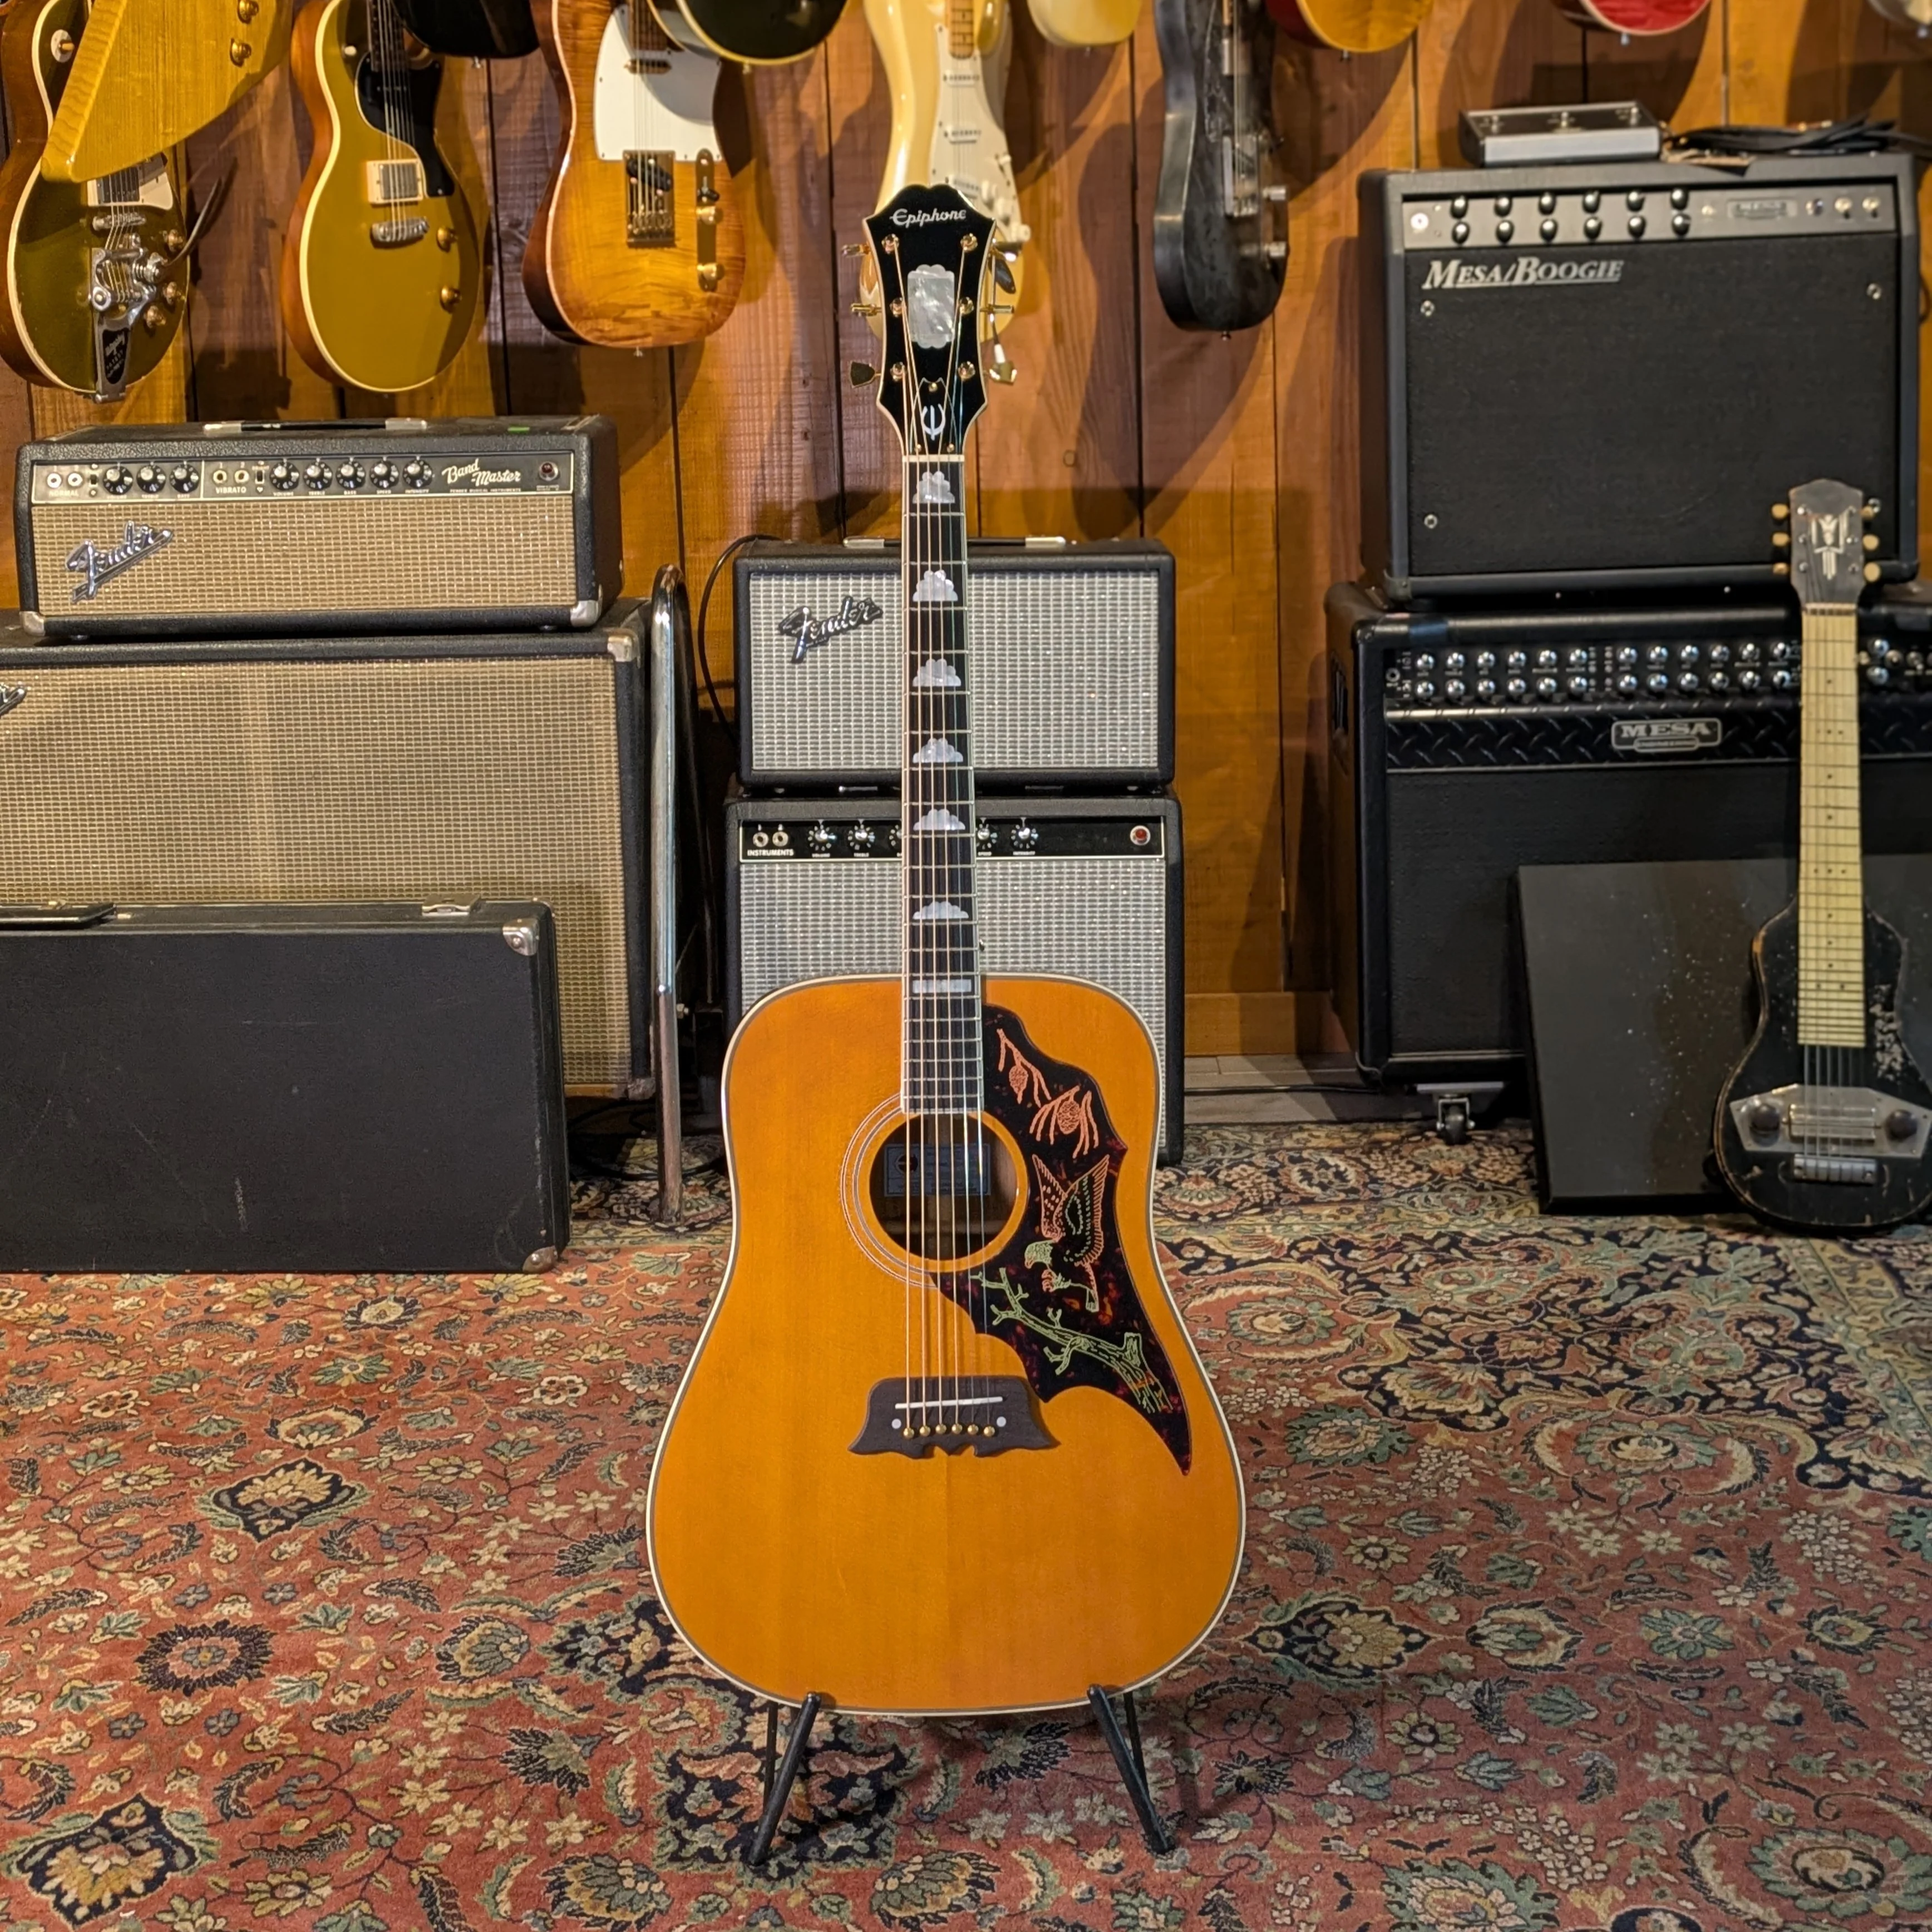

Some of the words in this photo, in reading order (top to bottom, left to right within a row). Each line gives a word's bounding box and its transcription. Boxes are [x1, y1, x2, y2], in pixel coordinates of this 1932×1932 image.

[889, 208, 967, 229] Epiphone
[1421, 257, 1625, 290] MESA/BOOGIE
[441, 458, 480, 484] Band
[65, 520, 174, 604] Fender
[778, 595, 884, 664] Fender
[1621, 722, 1711, 738] MESA
[747, 849, 795, 857] INSTRUMENTS
